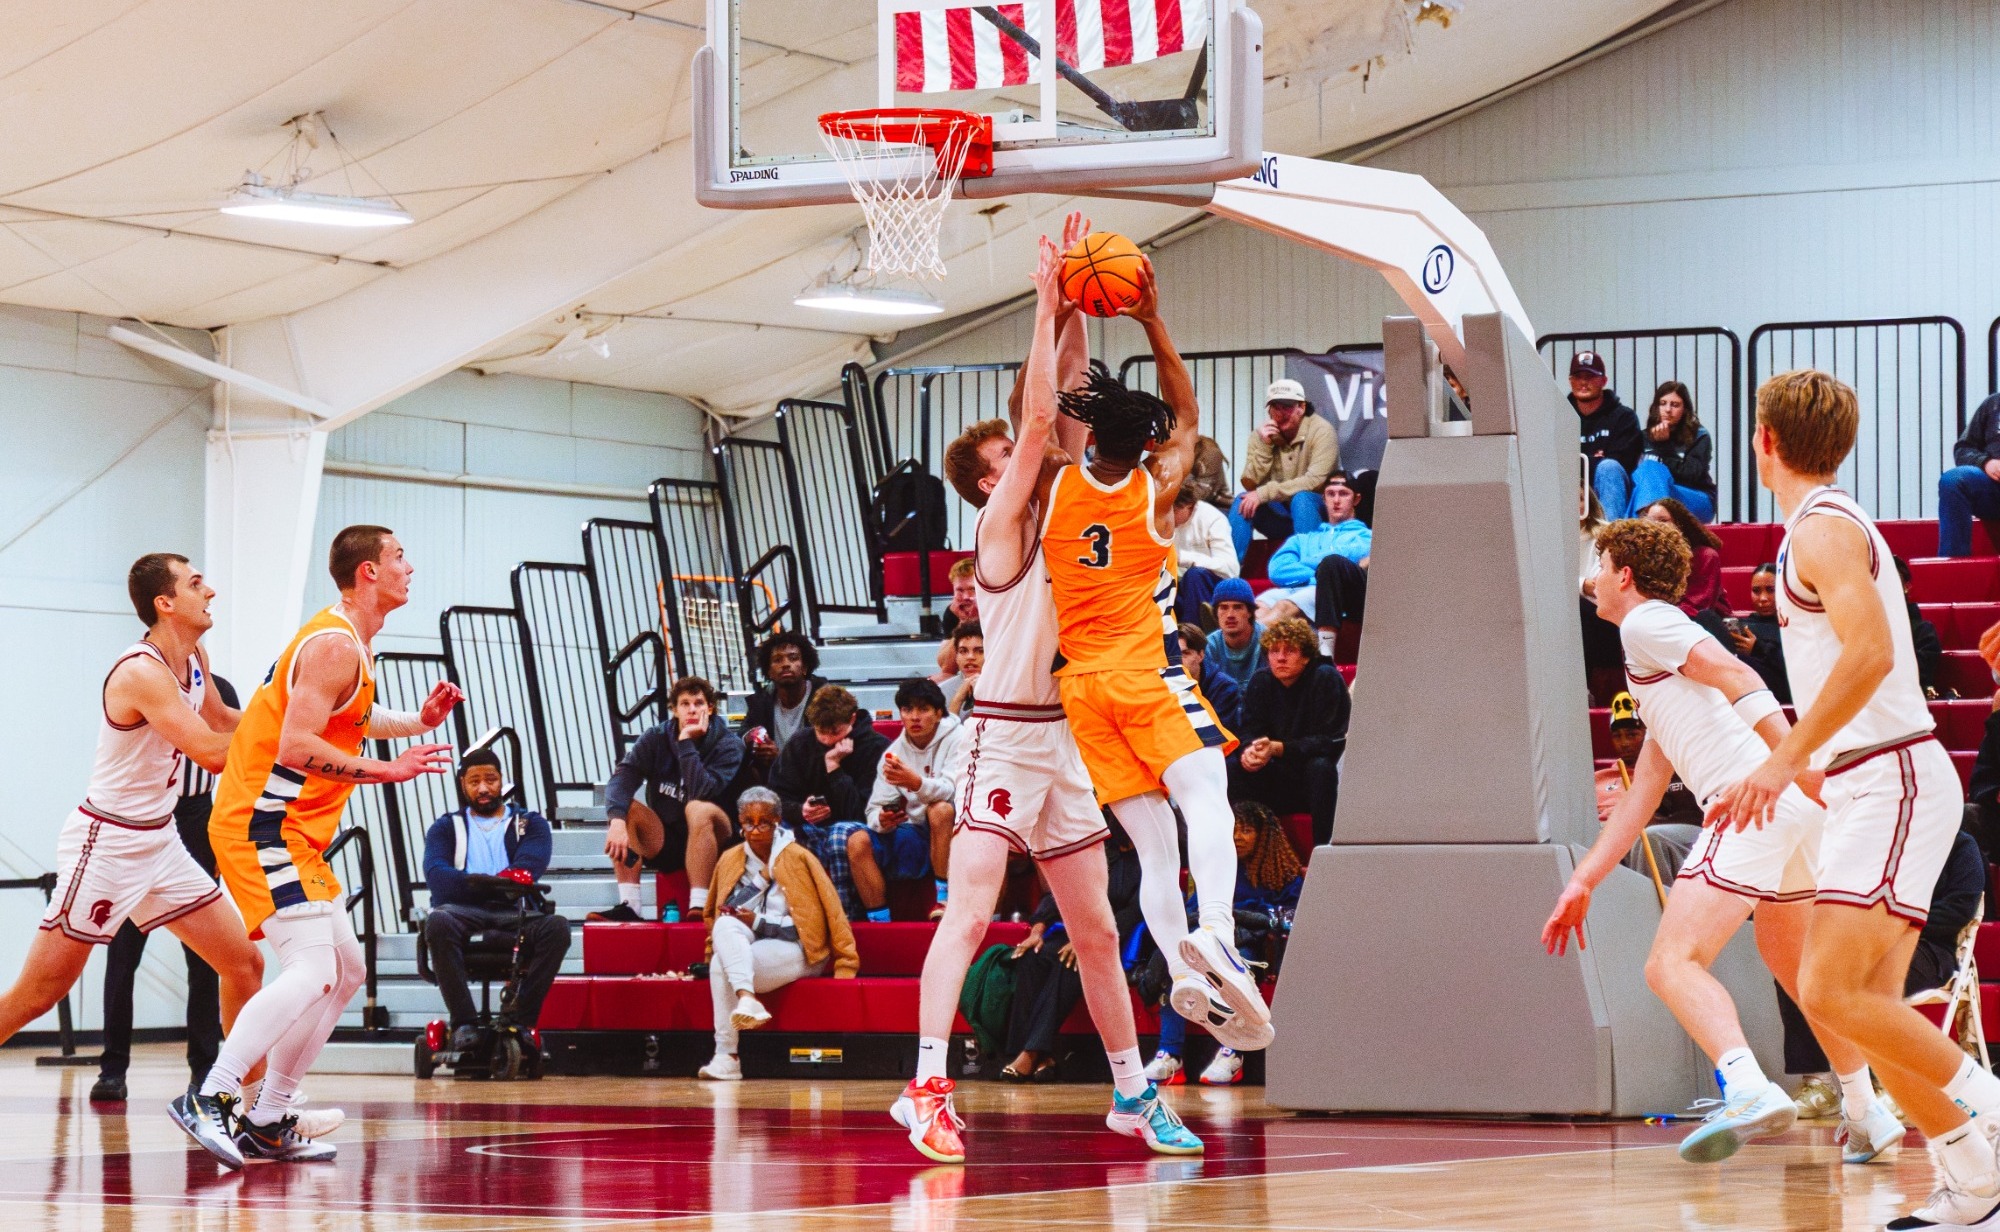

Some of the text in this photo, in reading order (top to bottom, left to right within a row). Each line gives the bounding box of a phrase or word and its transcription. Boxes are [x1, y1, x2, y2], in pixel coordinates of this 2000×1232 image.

[730, 167, 779, 183] SPALDING
[1078, 523, 1113, 570] 3
[166, 748, 183, 789] 2
[303, 756, 367, 779] LOVE
